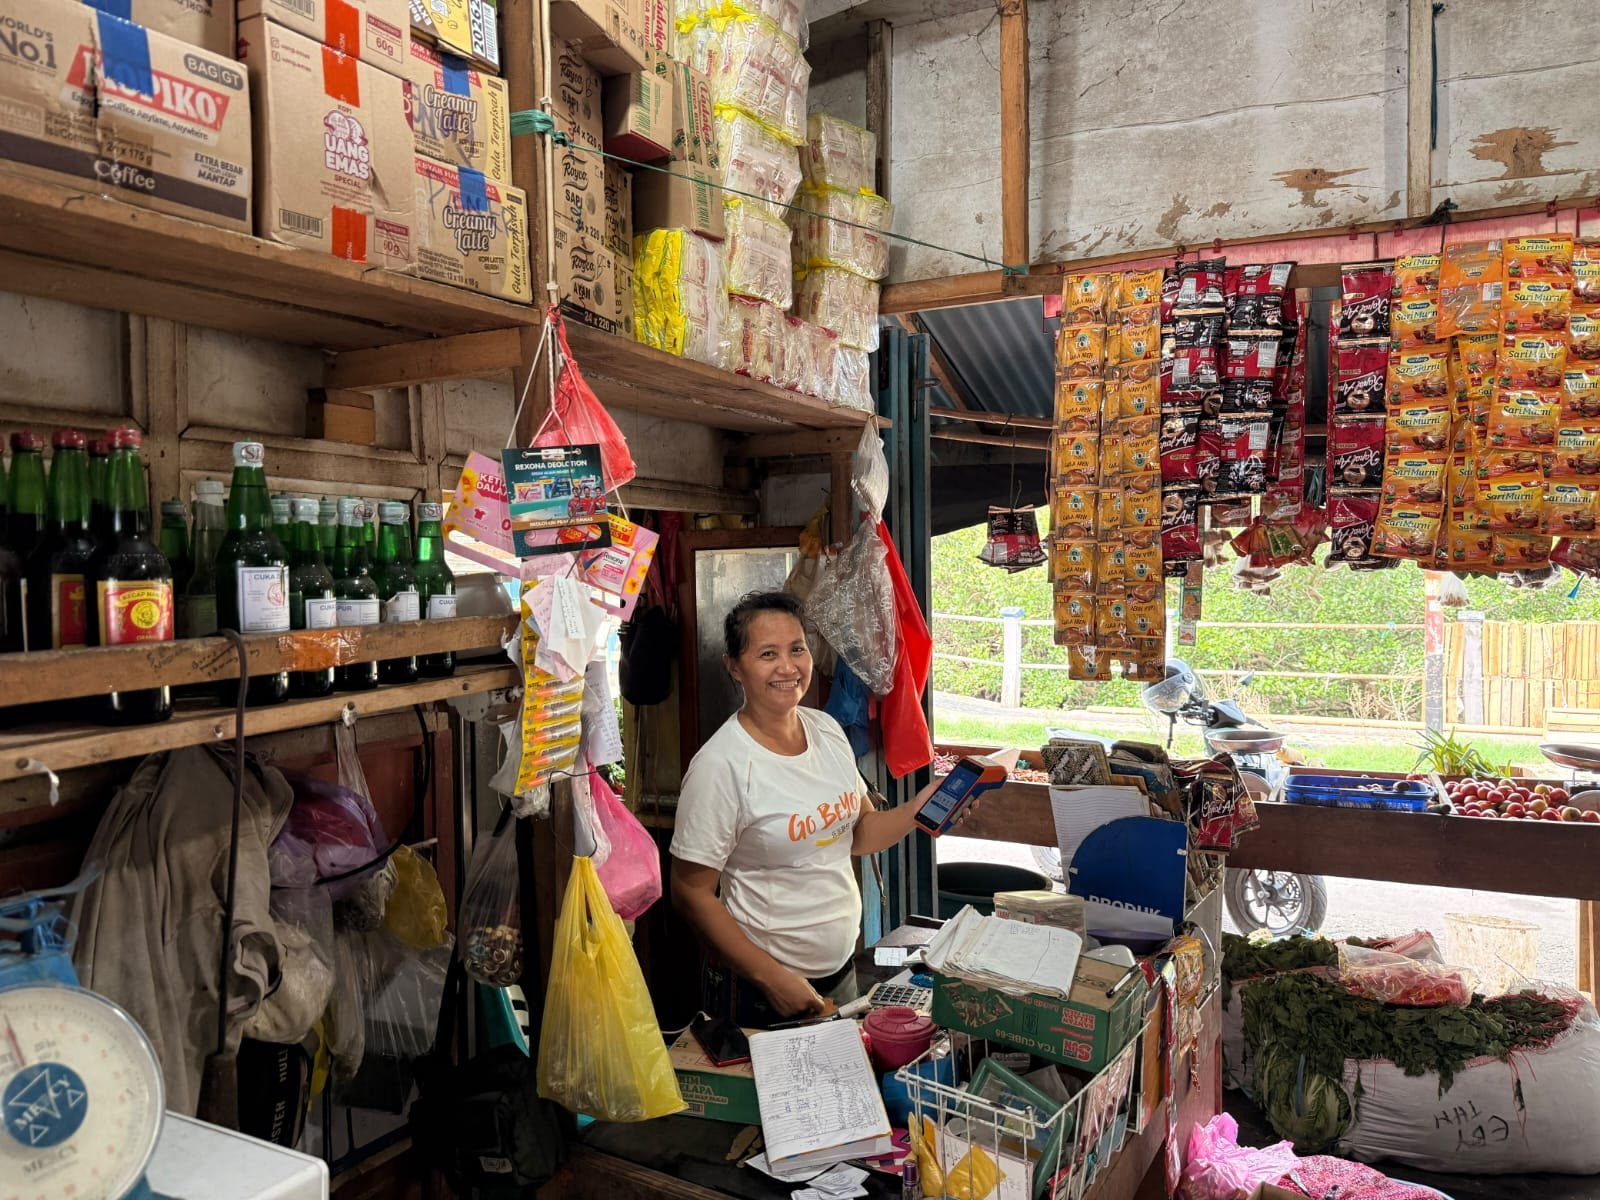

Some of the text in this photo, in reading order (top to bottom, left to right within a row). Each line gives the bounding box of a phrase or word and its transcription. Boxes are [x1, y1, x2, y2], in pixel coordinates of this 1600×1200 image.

[187, 57, 240, 87] BAG GT
[424, 84, 478, 123] Creamy
[435, 107, 472, 134] Latte
[324, 132, 370, 164] UANG
[94, 159, 156, 189] Coffee
[194, 152, 243, 176] EXTRA BESAR
[198, 169, 236, 188] MANTAP
[325, 150, 370, 181] EMAS
[443, 205, 497, 239] Creamy
[454, 229, 489, 257] Latte
[511, 264, 522, 295] Gula
[514, 462, 547, 472] REXONA
